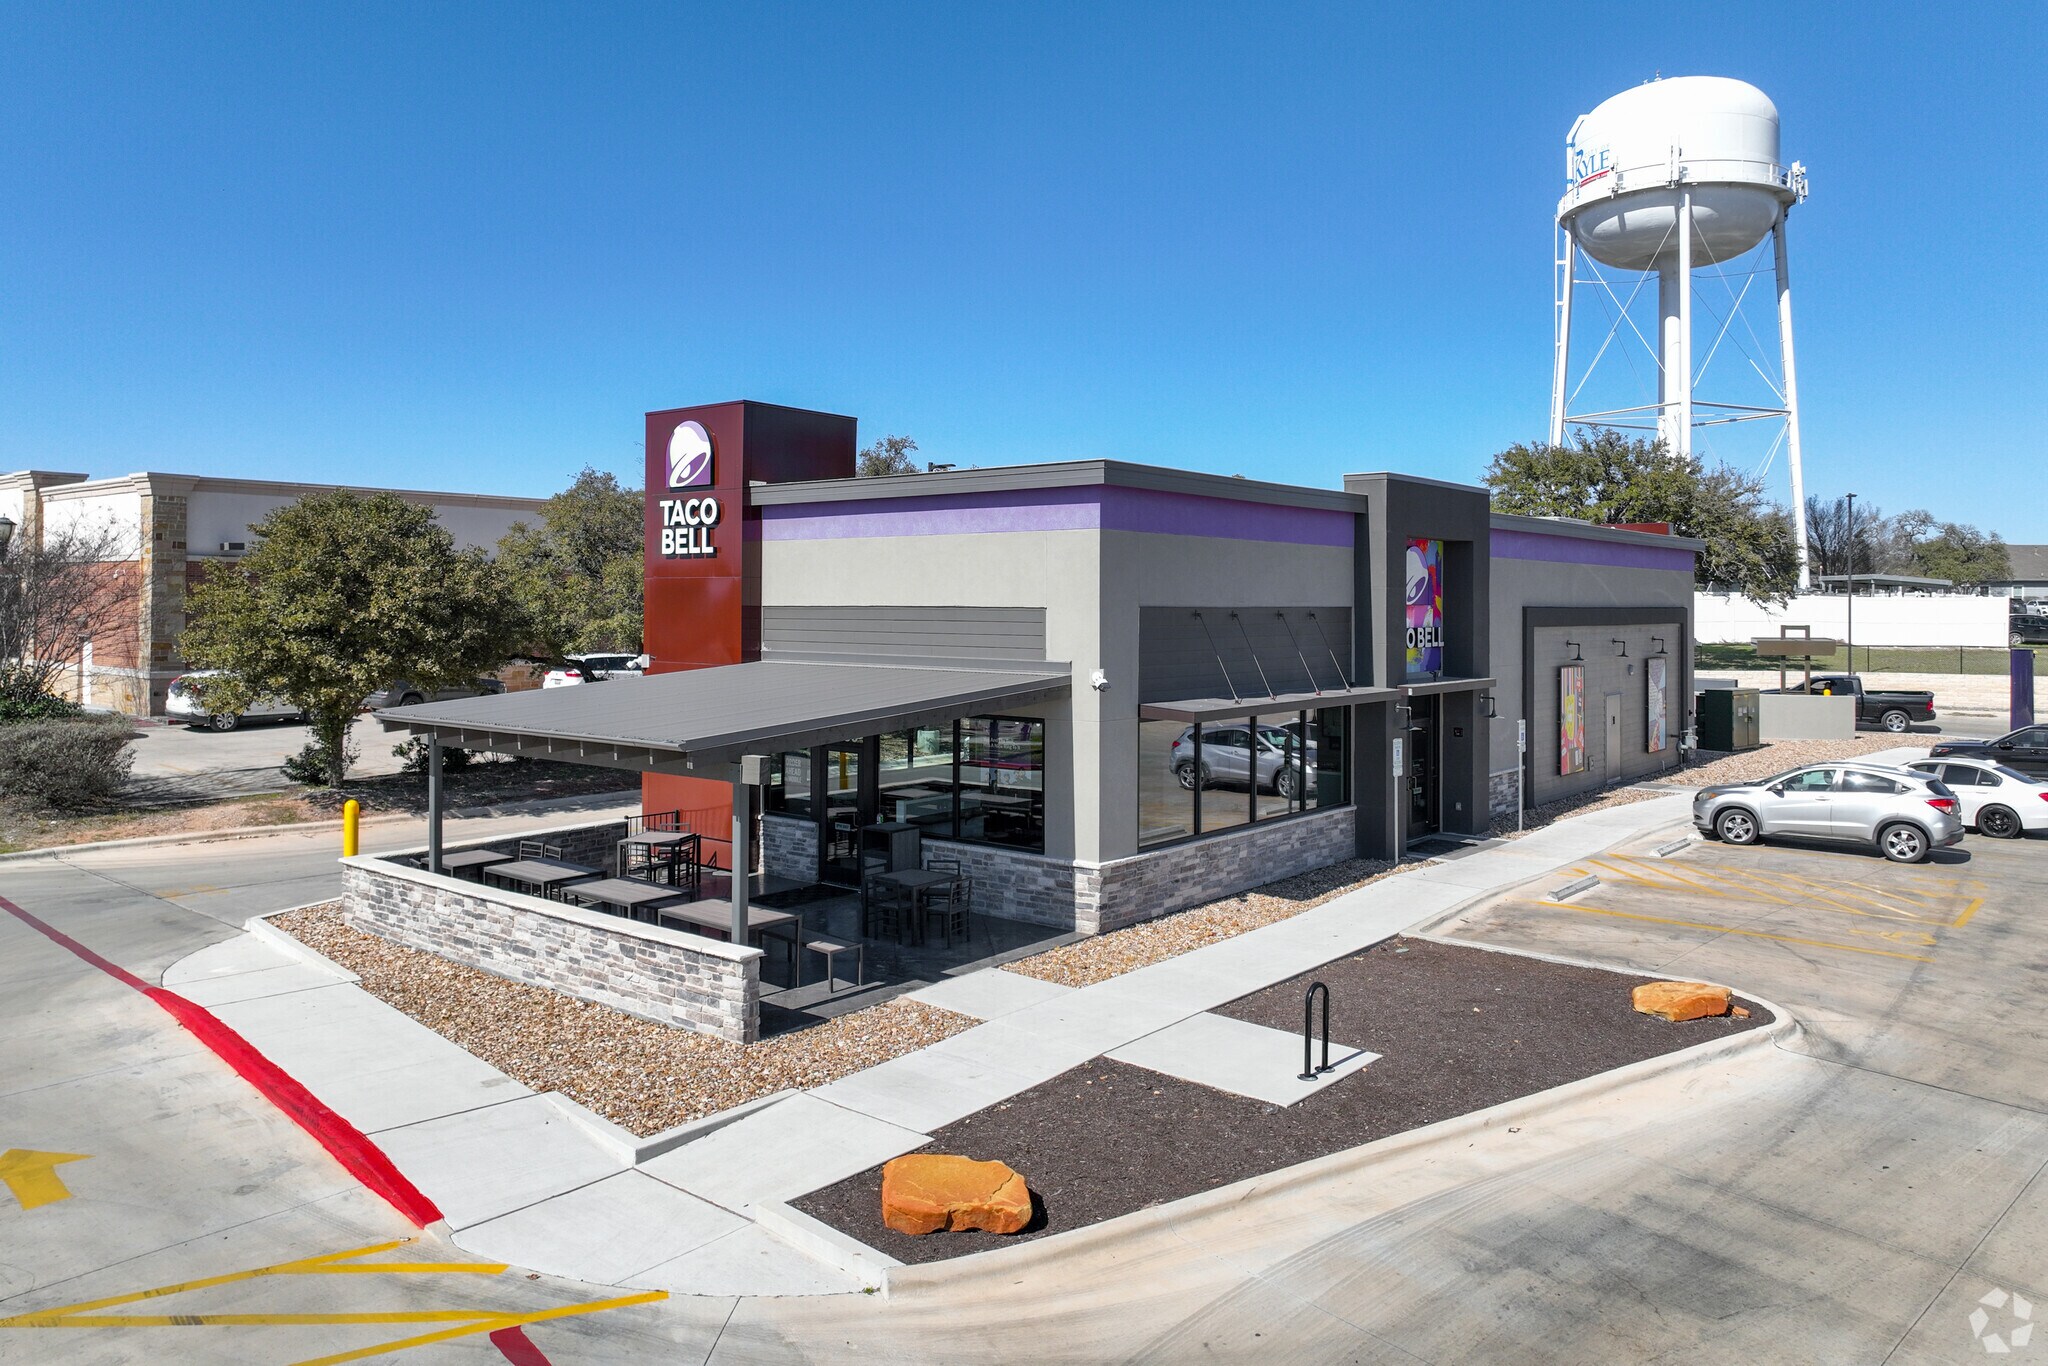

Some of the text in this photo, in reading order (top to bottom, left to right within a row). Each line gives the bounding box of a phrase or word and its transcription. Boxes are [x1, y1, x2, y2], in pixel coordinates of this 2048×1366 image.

[1575, 149, 1610, 183] KYLE
[659, 497, 718, 526] TACO
[661, 527, 714, 555] BELL
[1417, 627, 1445, 648] BELL
